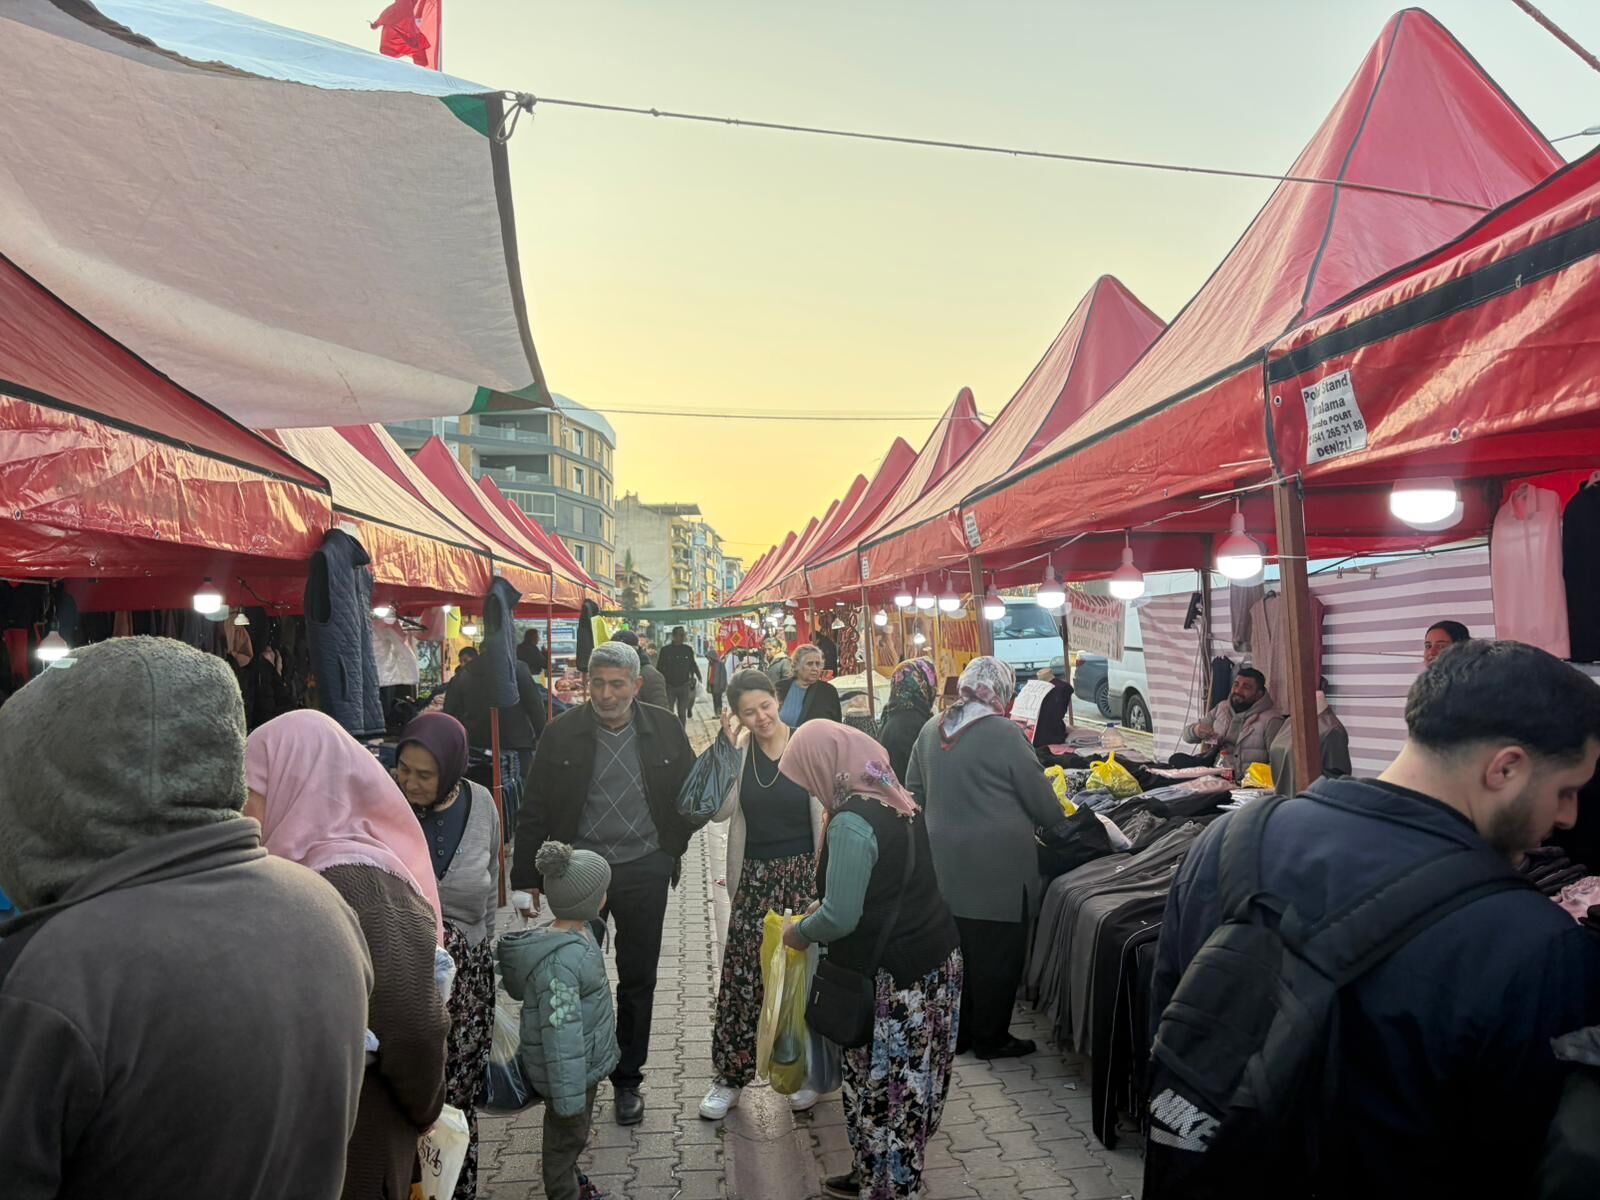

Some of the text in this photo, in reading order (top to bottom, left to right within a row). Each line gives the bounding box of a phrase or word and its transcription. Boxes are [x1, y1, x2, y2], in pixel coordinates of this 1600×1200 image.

[1321, 374, 1348, 394] Stand
[1328, 410, 1352, 424] POLAT
[1343, 424, 1352, 434] 31
[1150, 1088, 1221, 1140] NIKE
